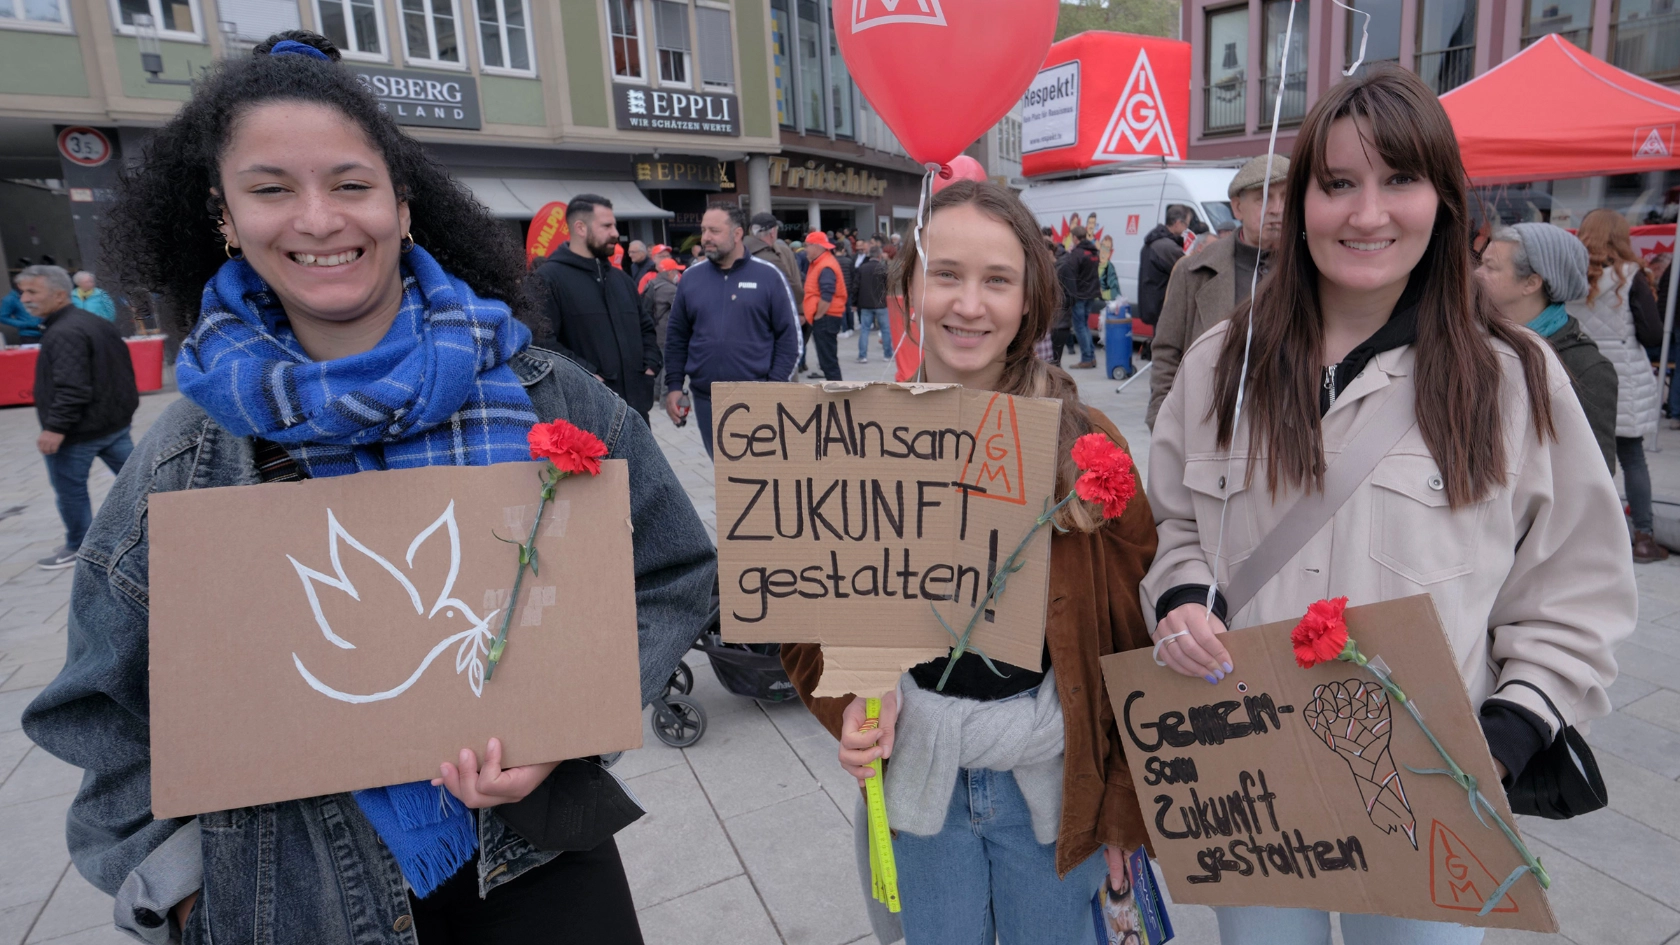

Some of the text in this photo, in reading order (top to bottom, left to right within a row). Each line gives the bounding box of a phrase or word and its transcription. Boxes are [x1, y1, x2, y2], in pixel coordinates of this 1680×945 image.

[650, 91, 730, 120] EPPLI
[1024, 73, 1074, 108] Respekt!
[1048, 106, 1073, 116] Rassismus
[629, 118, 732, 132] WIR SCHÄTZEN WERTE
[656, 162, 711, 180] EPPLI
[768, 156, 887, 197] Tritschler
[537, 206, 564, 248] MLPD
[717, 398, 977, 464] GeMAInsam
[727, 476, 987, 542] ZUKUNFT
[732, 528, 998, 623] gestalten!
[1153, 768, 1280, 839] Zukunft
[1186, 828, 1369, 884] gestalten
